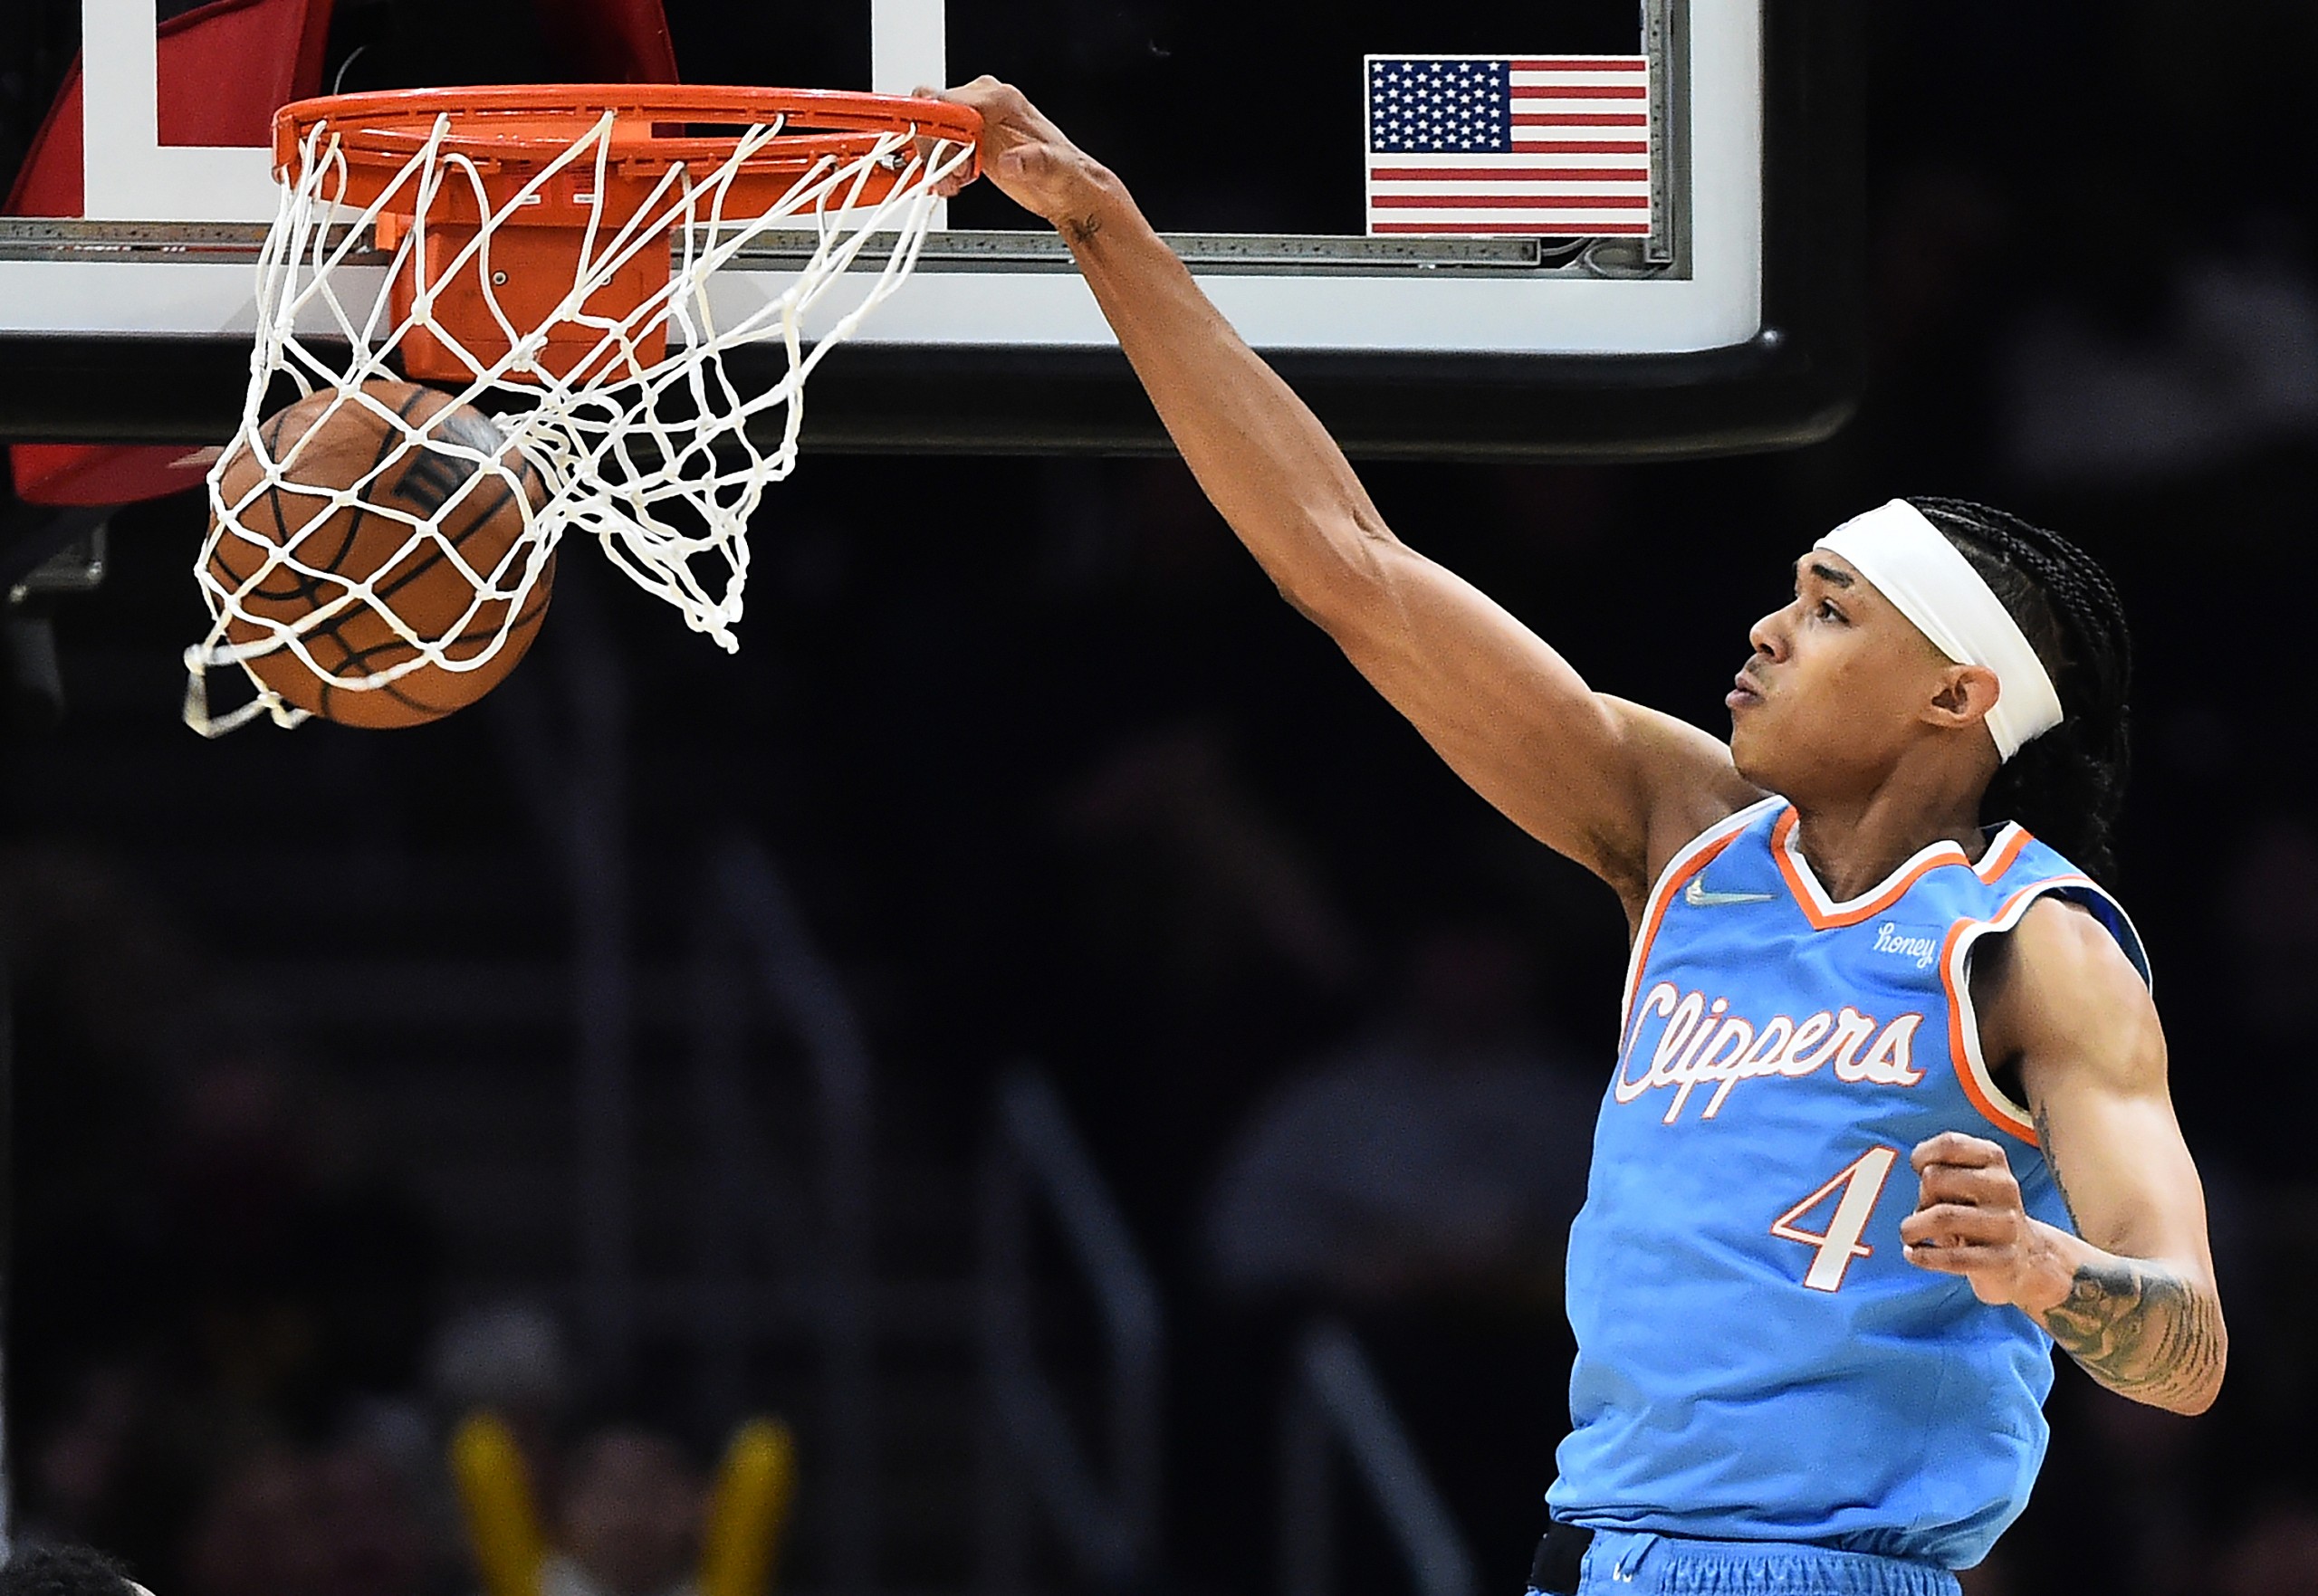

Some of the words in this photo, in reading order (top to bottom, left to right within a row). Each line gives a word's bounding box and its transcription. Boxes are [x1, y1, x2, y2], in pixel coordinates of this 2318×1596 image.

[1873, 922, 1936, 968] honey
[1614, 981, 1927, 1124] Clippers
[1769, 1145, 1900, 1293] 4
